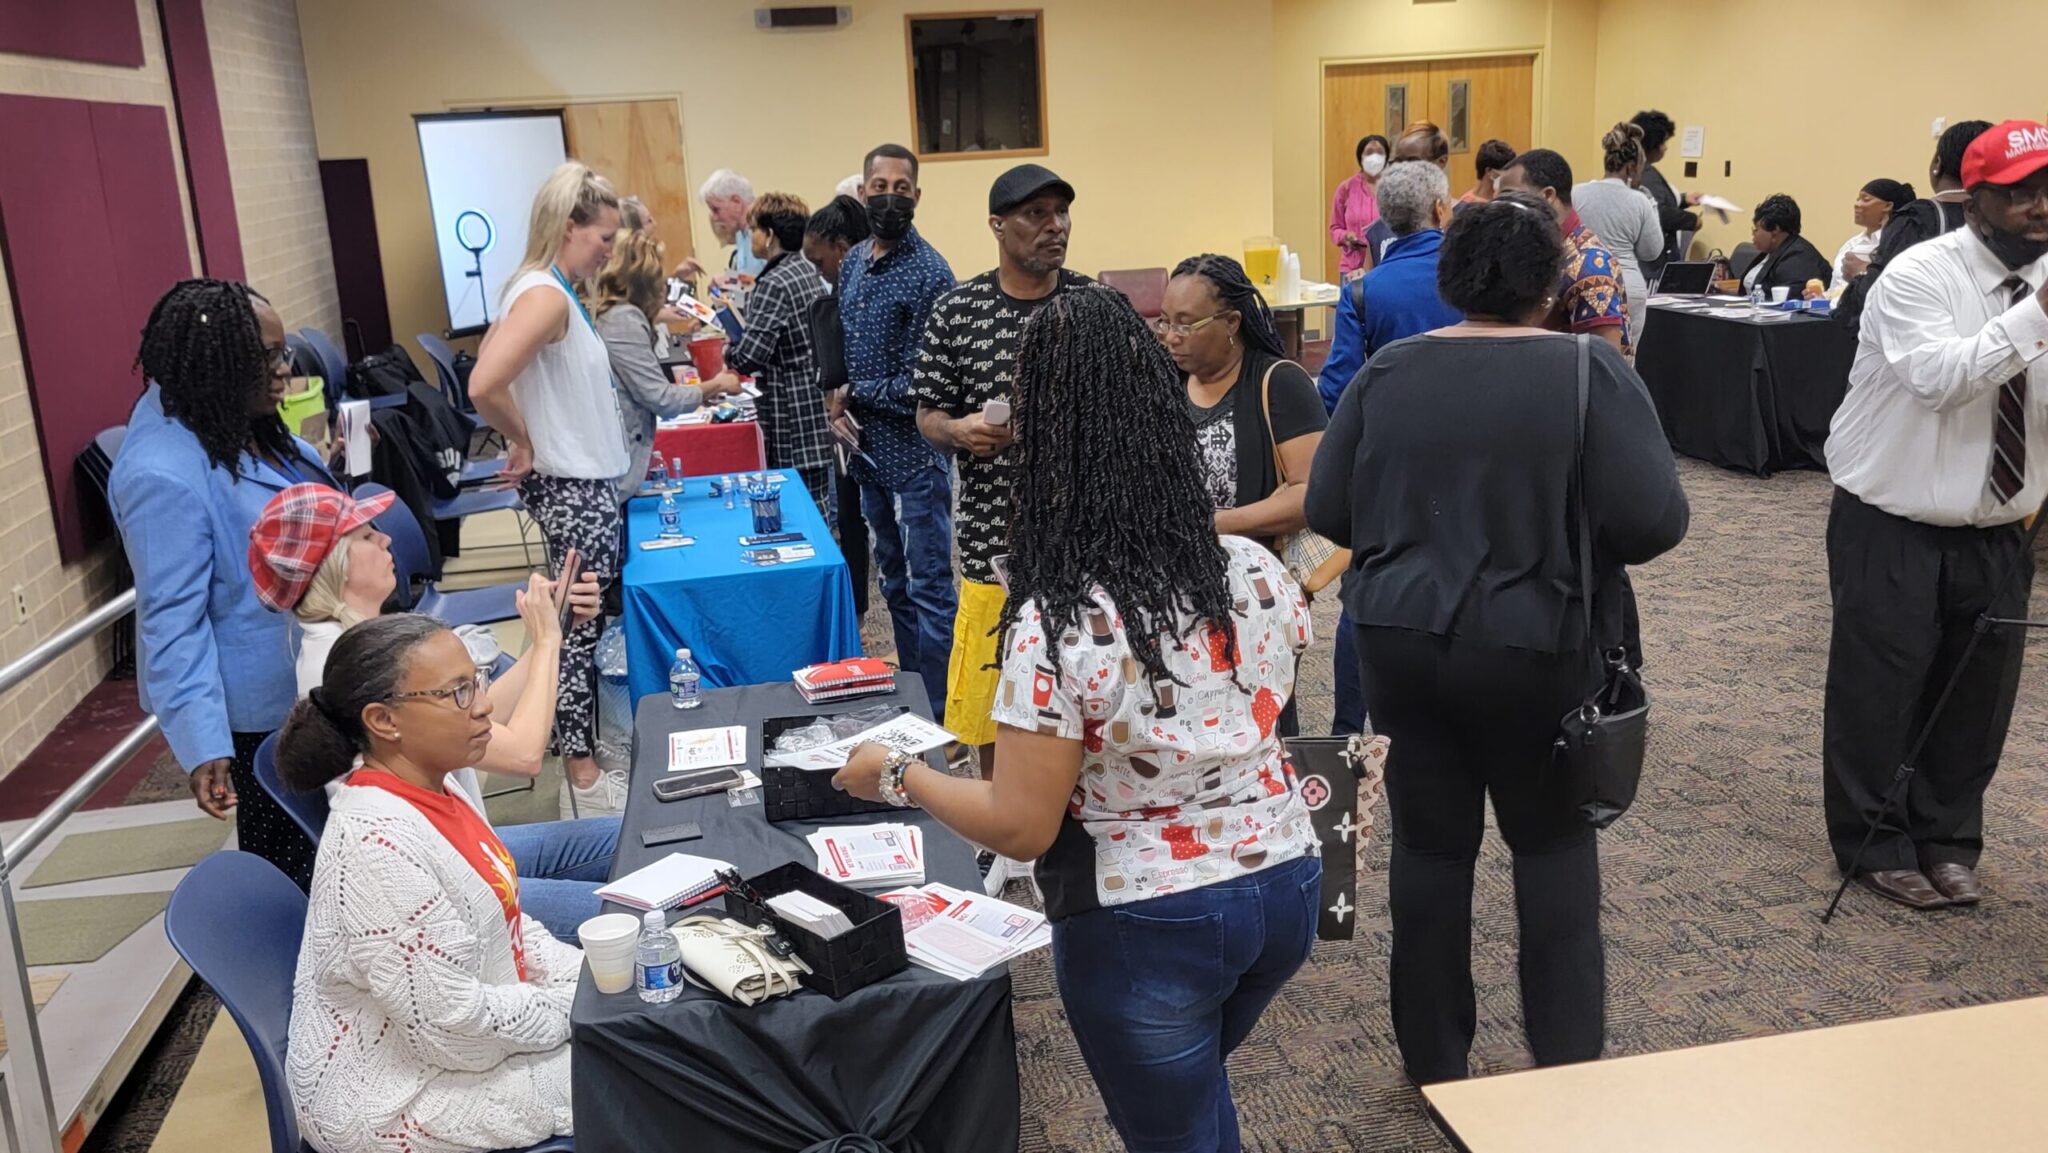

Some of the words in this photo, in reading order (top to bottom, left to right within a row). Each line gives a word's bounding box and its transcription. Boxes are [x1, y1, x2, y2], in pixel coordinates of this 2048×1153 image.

[948, 296, 972, 304] GOAT
[995, 310, 1019, 318] GOAT
[949, 316, 973, 325] GOAT
[971, 318, 994, 328] GOAT
[995, 331, 1018, 339] GOAT
[951, 336, 972, 346] GOAT
[971, 339, 994, 348] GOAT
[972, 361, 993, 370] GOAT
[928, 371, 952, 385] GOAT
[995, 374, 1012, 382] GOA
[918, 387, 941, 401] GOAT
[975, 502, 992, 510] GOAT
[971, 521, 990, 530] GOAT
[969, 540, 988, 549] GOAT
[966, 558, 986, 567] GOAT
[1151, 866, 1188, 881] Espresso
